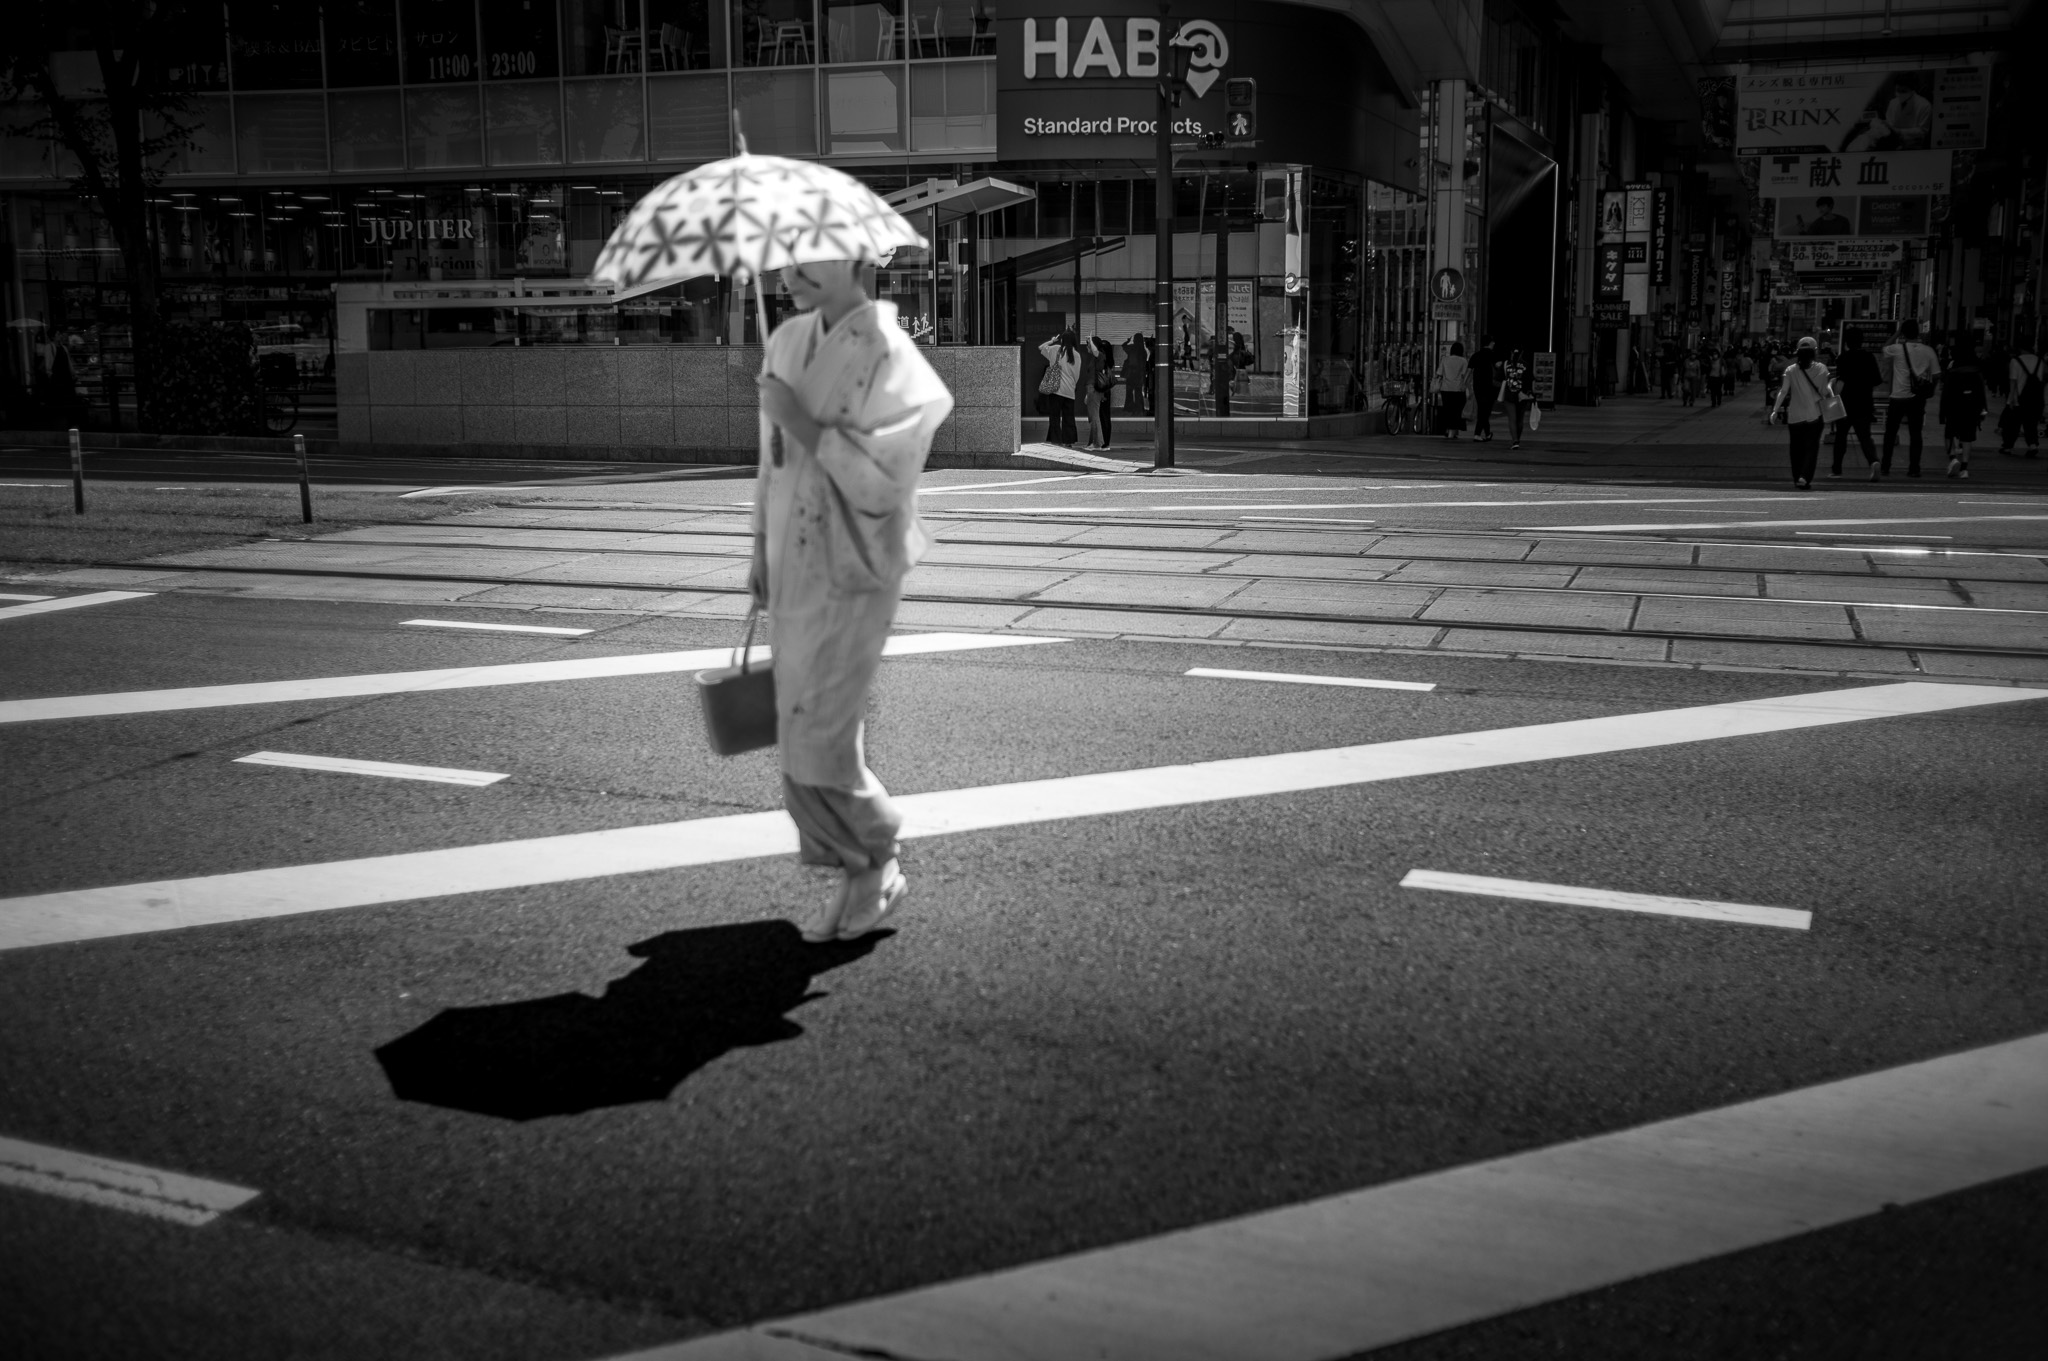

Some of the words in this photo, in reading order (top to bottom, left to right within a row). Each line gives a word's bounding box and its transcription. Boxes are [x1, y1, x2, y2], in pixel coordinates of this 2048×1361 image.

[429, 54, 470, 80] 11:00
[492, 50, 536, 77] 23:00
[1024, 117, 1112, 135] Standard
[1118, 117, 1202, 135] Prodcts
[1771, 107, 1841, 127] RINX
[1809, 156, 1889, 188] 献血
[1932, 182, 1945, 191] 5F
[364, 218, 475, 244] JUPITER
[1600, 312, 1623, 320] SALE
